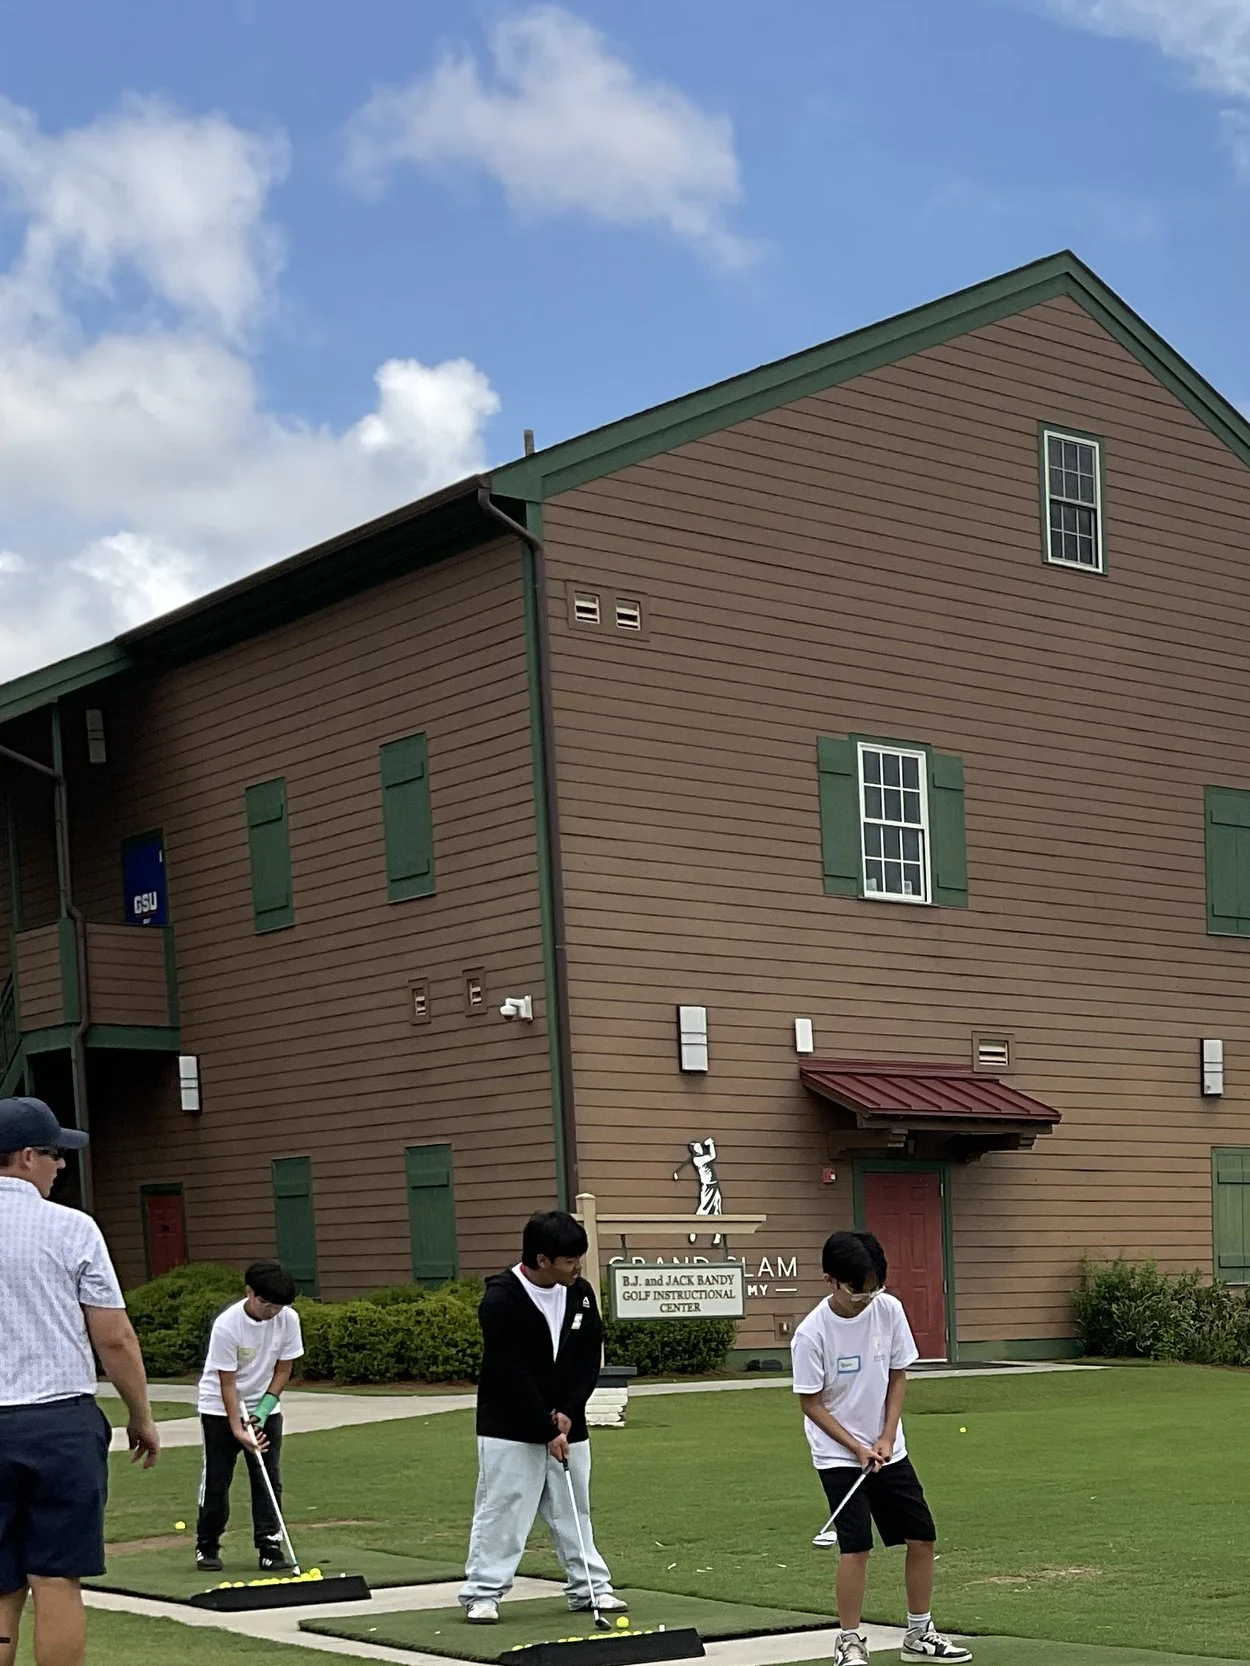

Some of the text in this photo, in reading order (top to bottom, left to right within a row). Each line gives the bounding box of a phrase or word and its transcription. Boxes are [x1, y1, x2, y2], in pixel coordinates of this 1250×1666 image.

[133, 891, 157, 914] GSU
[622, 1274, 735, 1286] B.J. and JACK BANDY
[622, 1289, 736, 1301] GOLF INSTRUCTIONAL
[660, 1302, 701, 1313] CENTER
